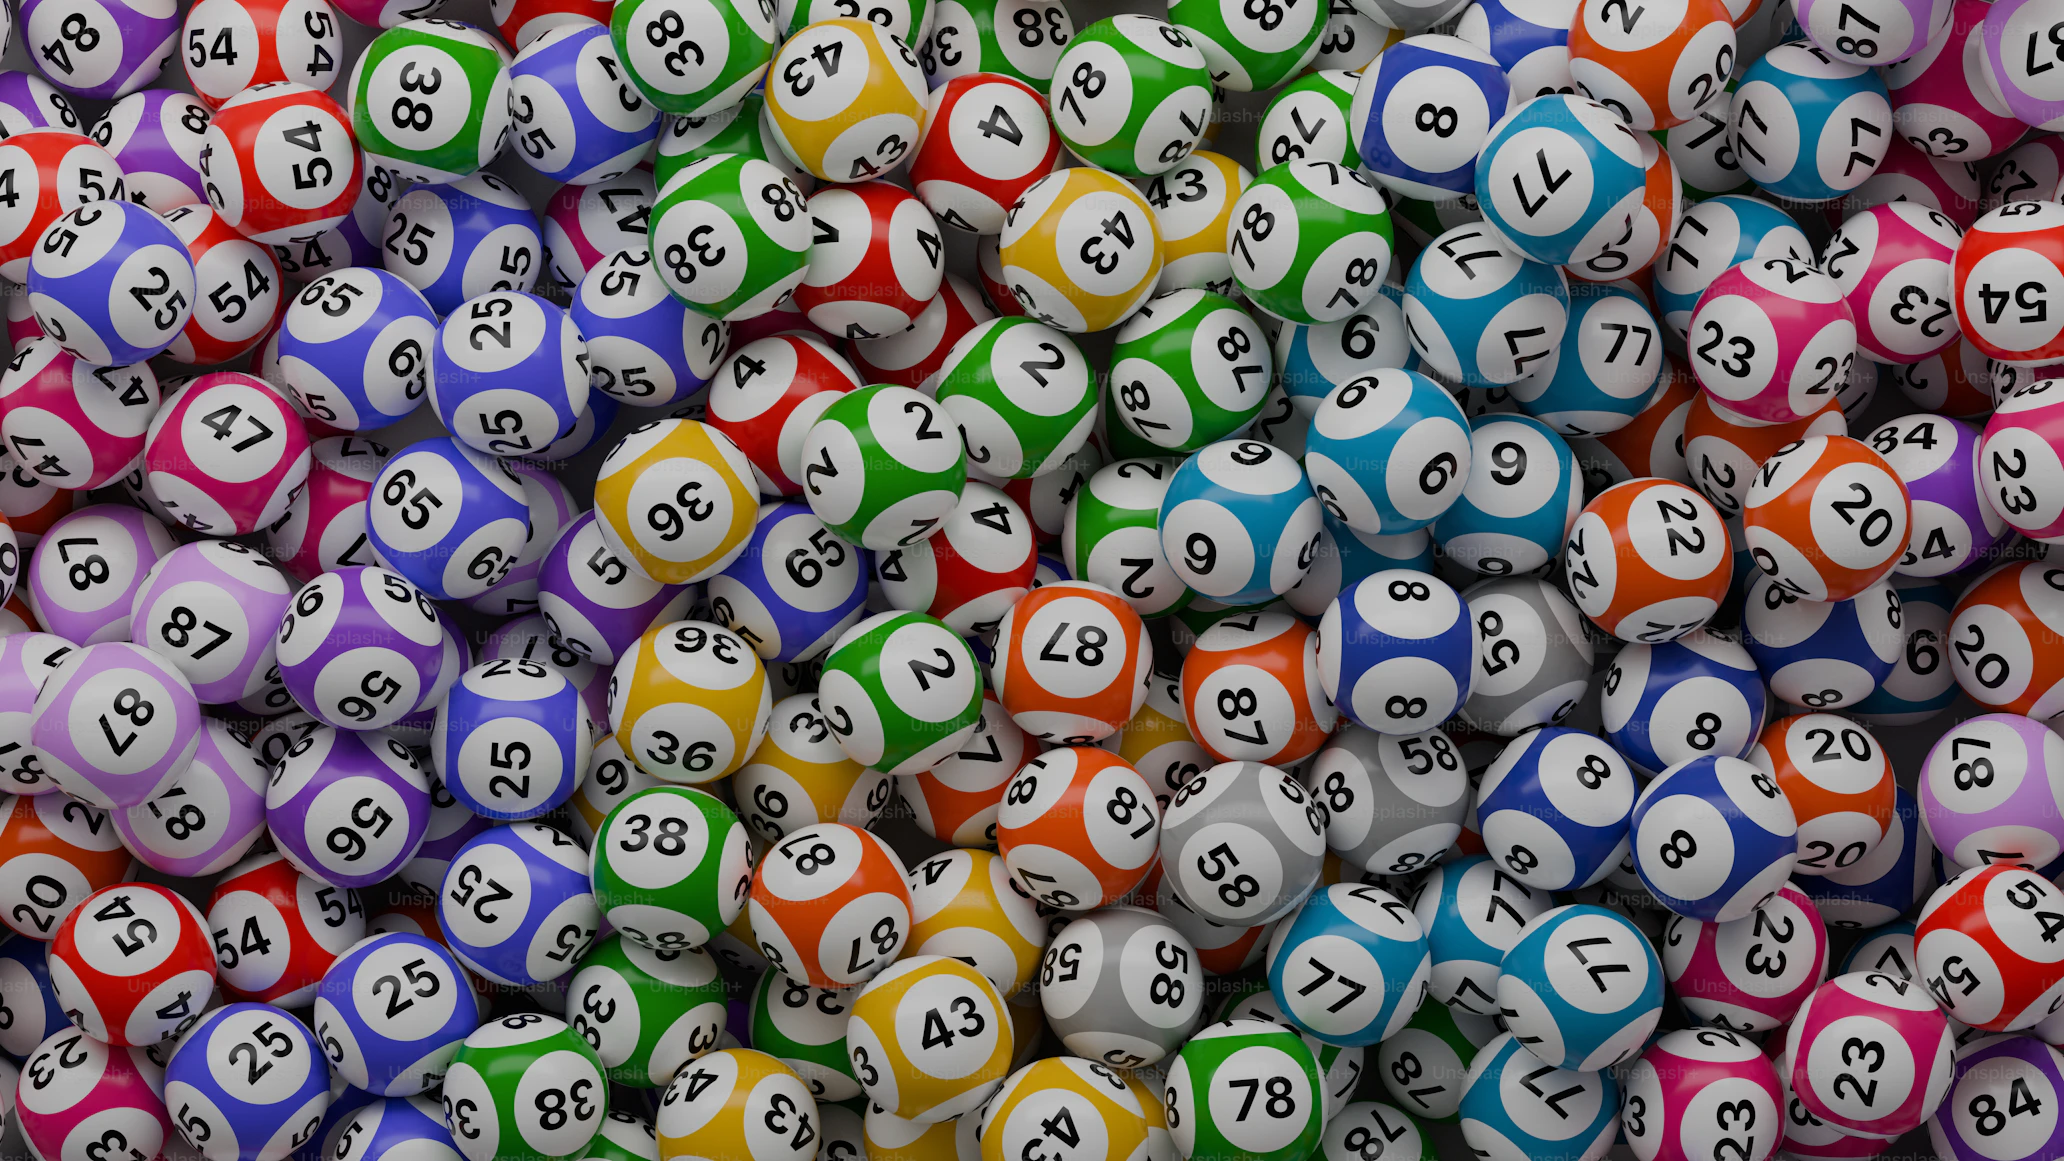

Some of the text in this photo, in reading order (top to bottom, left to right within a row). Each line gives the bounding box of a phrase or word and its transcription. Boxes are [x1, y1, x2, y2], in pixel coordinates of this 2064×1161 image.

[40, 12, 101, 76] 84
[189, 27, 238, 68] 54
[304, 10, 334, 77] 54
[645, 9, 705, 77] 38
[1012, 6, 1068, 48] 38
[1835, 2, 1881, 59] 87
[783, 40, 844, 97] 43
[1059, 61, 1107, 127] 78
[1687, 43, 1734, 111] 20
[391, 61, 442, 132] 38
[1415, 102, 1458, 139] 8
[512, 94, 556, 160] 25
[977, 104, 1024, 147] 4
[1158, 108, 1206, 164] 78
[1271, 106, 1326, 165] 78
[1843, 117, 1882, 177] 77
[282, 120, 333, 190] 54
[848, 134, 908, 180] 43
[597, 187, 652, 234] 47
[1150, 168, 1208, 210] 43
[1512, 148, 1573, 218] 77
[385, 212, 431, 266] 25
[664, 224, 726, 285] 38
[916, 228, 942, 270] 4
[1080, 210, 1135, 275] 43
[1230, 203, 1275, 272] 78
[1437, 231, 1503, 280] 77
[1665, 215, 1710, 272] 77
[128, 266, 187, 331] 25
[208, 258, 271, 324] 54
[300, 277, 364, 317] 65
[600, 250, 652, 297] 25
[1325, 257, 1378, 309] 78
[469, 298, 513, 351] 25
[1890, 285, 1953, 338] 23
[1978, 281, 2047, 324] 54
[1217, 326, 1264, 394] 78
[1340, 313, 1380, 360] 6
[1503, 326, 1551, 376] 77
[1600, 323, 1652, 367] 77
[1696, 320, 1756, 378] 23
[91, 364, 150, 407] 47
[590, 365, 656, 398] 25
[733, 353, 767, 390] 4
[1019, 342, 1066, 389] 2
[1336, 376, 1380, 409] 6
[200, 404, 274, 453] 47
[478, 409, 533, 453] 25
[903, 401, 943, 441] 2
[1120, 380, 1172, 439] 78
[1872, 422, 1938, 455] 84
[1117, 461, 1164, 482] 2
[1418, 451, 1458, 496] 6
[1993, 448, 2037, 515] 23
[383, 469, 443, 530] 65
[970, 502, 1013, 535] 4
[1830, 482, 1893, 548] 20
[1656, 498, 1706, 557] 22
[57, 537, 110, 591] 87
[785, 527, 846, 589] 65
[1120, 557, 1155, 599] 2
[1388, 580, 1431, 602] 8
[161, 606, 233, 661] 87
[674, 627, 742, 665] 36
[1039, 622, 1108, 667] 87
[1476, 610, 1520, 677] 58
[1953, 623, 2010, 689] 20
[337, 670, 402, 722] 56
[481, 658, 547, 679] 25
[907, 647, 956, 692] 2
[98, 688, 155, 758] 87
[1217, 687, 1269, 746] 87
[1384, 695, 1428, 720] 8
[1686, 712, 1722, 751] 8
[488, 741, 532, 799] 25
[646, 730, 717, 773] 36
[1396, 734, 1458, 776] 58
[1576, 754, 1611, 790] 8
[1805, 728, 1872, 763] 20
[1951, 737, 1995, 792] 87
[1106, 786, 1156, 840] 87
[1750, 773, 1782, 799] 8
[325, 797, 394, 862] 56
[620, 814, 689, 857] 38
[778, 833, 836, 876] 87
[1659, 829, 1698, 870] 8
[1796, 840, 1868, 869] 20
[1197, 841, 1261, 908] 58
[1504, 844, 1539, 875] 8
[12, 874, 68, 934] 20
[450, 864, 514, 924] 25
[93, 895, 158, 958] 54
[211, 915, 272, 970] 54
[846, 916, 899, 975] 87
[1745, 909, 1795, 980] 23
[372, 958, 440, 1020] 25
[1042, 943, 1082, 987] 58
[1149, 940, 1189, 1009] 58
[1297, 956, 1367, 1014] 77
[1566, 937, 1631, 994] 77
[1926, 955, 1981, 1010] 54
[570, 984, 616, 1052] 38
[921, 996, 985, 1051] 43
[28, 1034, 88, 1091] 23
[228, 1021, 294, 1086] 25
[1391, 1051, 1446, 1109] 78
[1833, 1037, 1885, 1108] 23
[534, 1078, 596, 1131] 38
[1228, 1076, 1296, 1122] 78
[1519, 1064, 1587, 1121] 77
[1968, 1076, 2042, 1137] 84
[764, 1093, 816, 1152] 43
